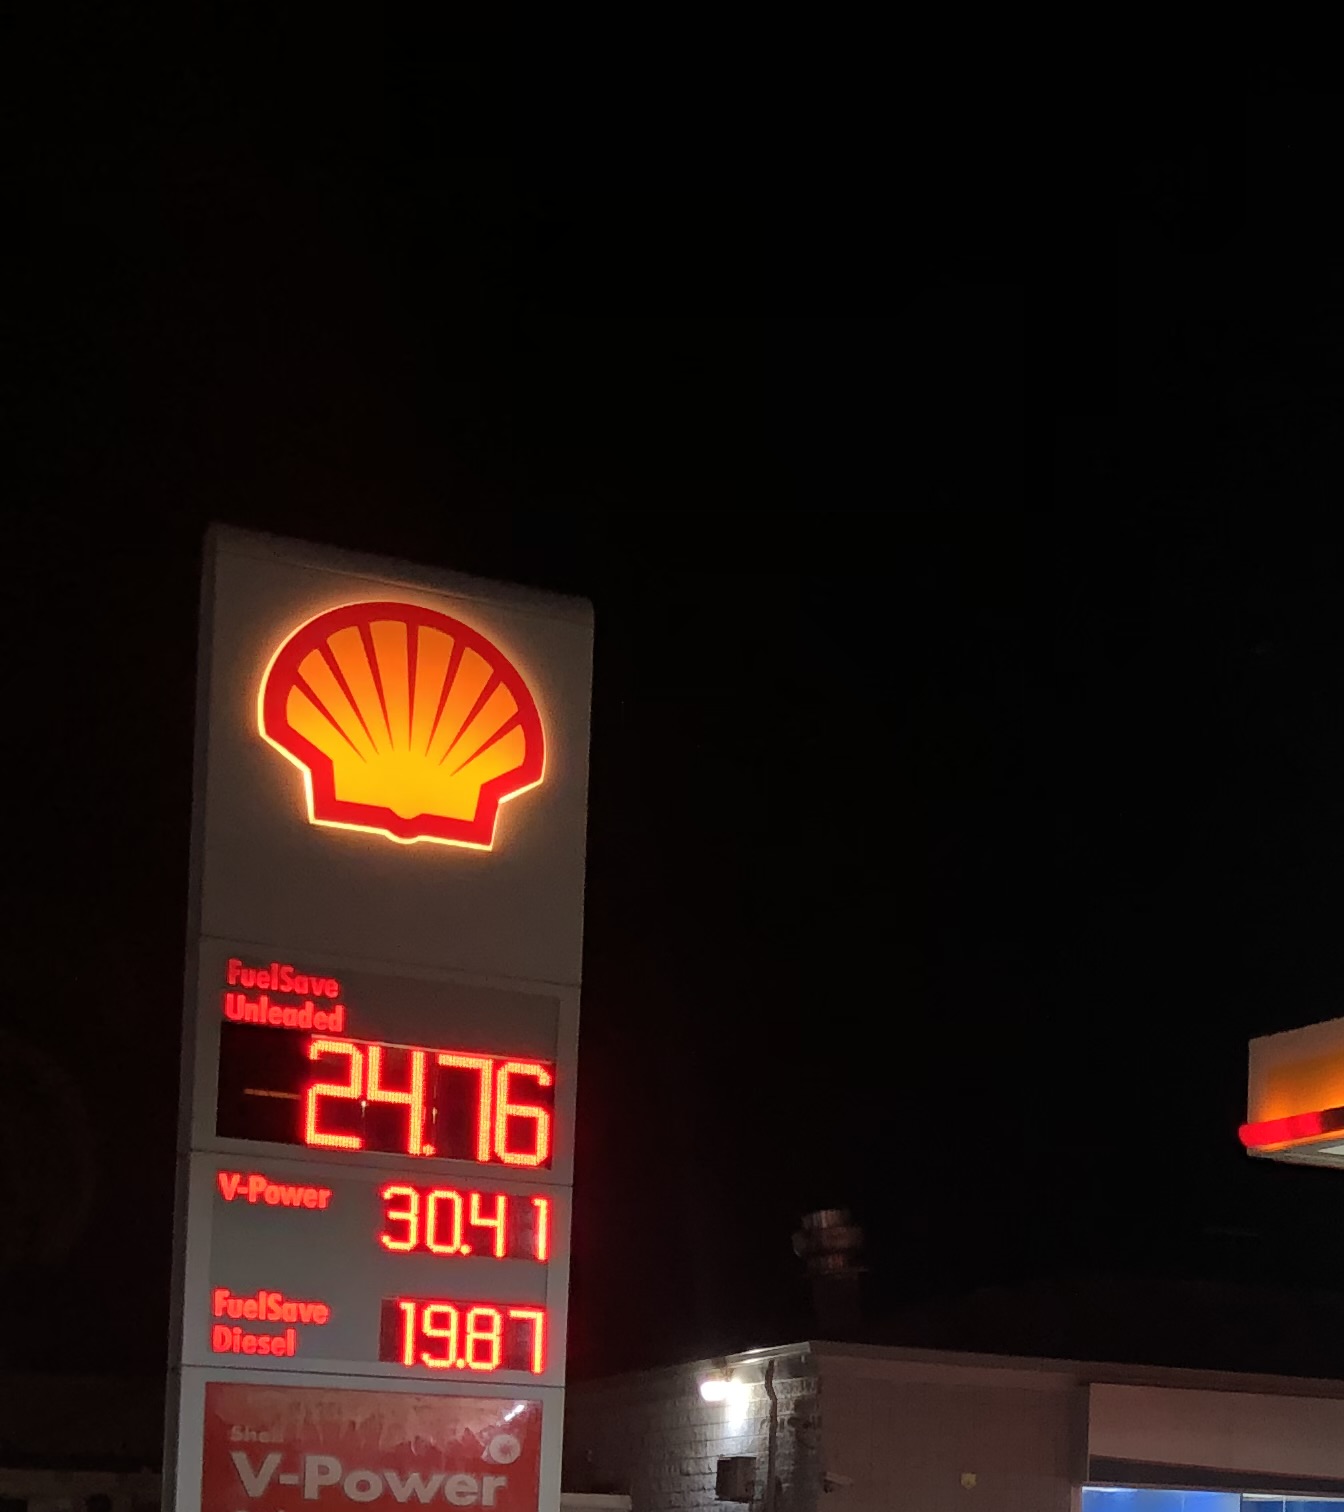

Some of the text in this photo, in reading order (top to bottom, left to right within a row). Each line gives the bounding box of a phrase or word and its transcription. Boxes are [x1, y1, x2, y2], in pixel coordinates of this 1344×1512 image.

[227, 959, 340, 999] FuelSave
[225, 994, 344, 1032] Unleaded
[305, 1038, 553, 1167] 24.76
[218, 1171, 332, 1210] V-Power
[380, 1186, 549, 1261] 30.41
[213, 1288, 330, 1325] FuelSave
[212, 1326, 296, 1357] Diesel
[399, 1301, 545, 1374] 19.87
[230, 1450, 507, 1507] V-Power
